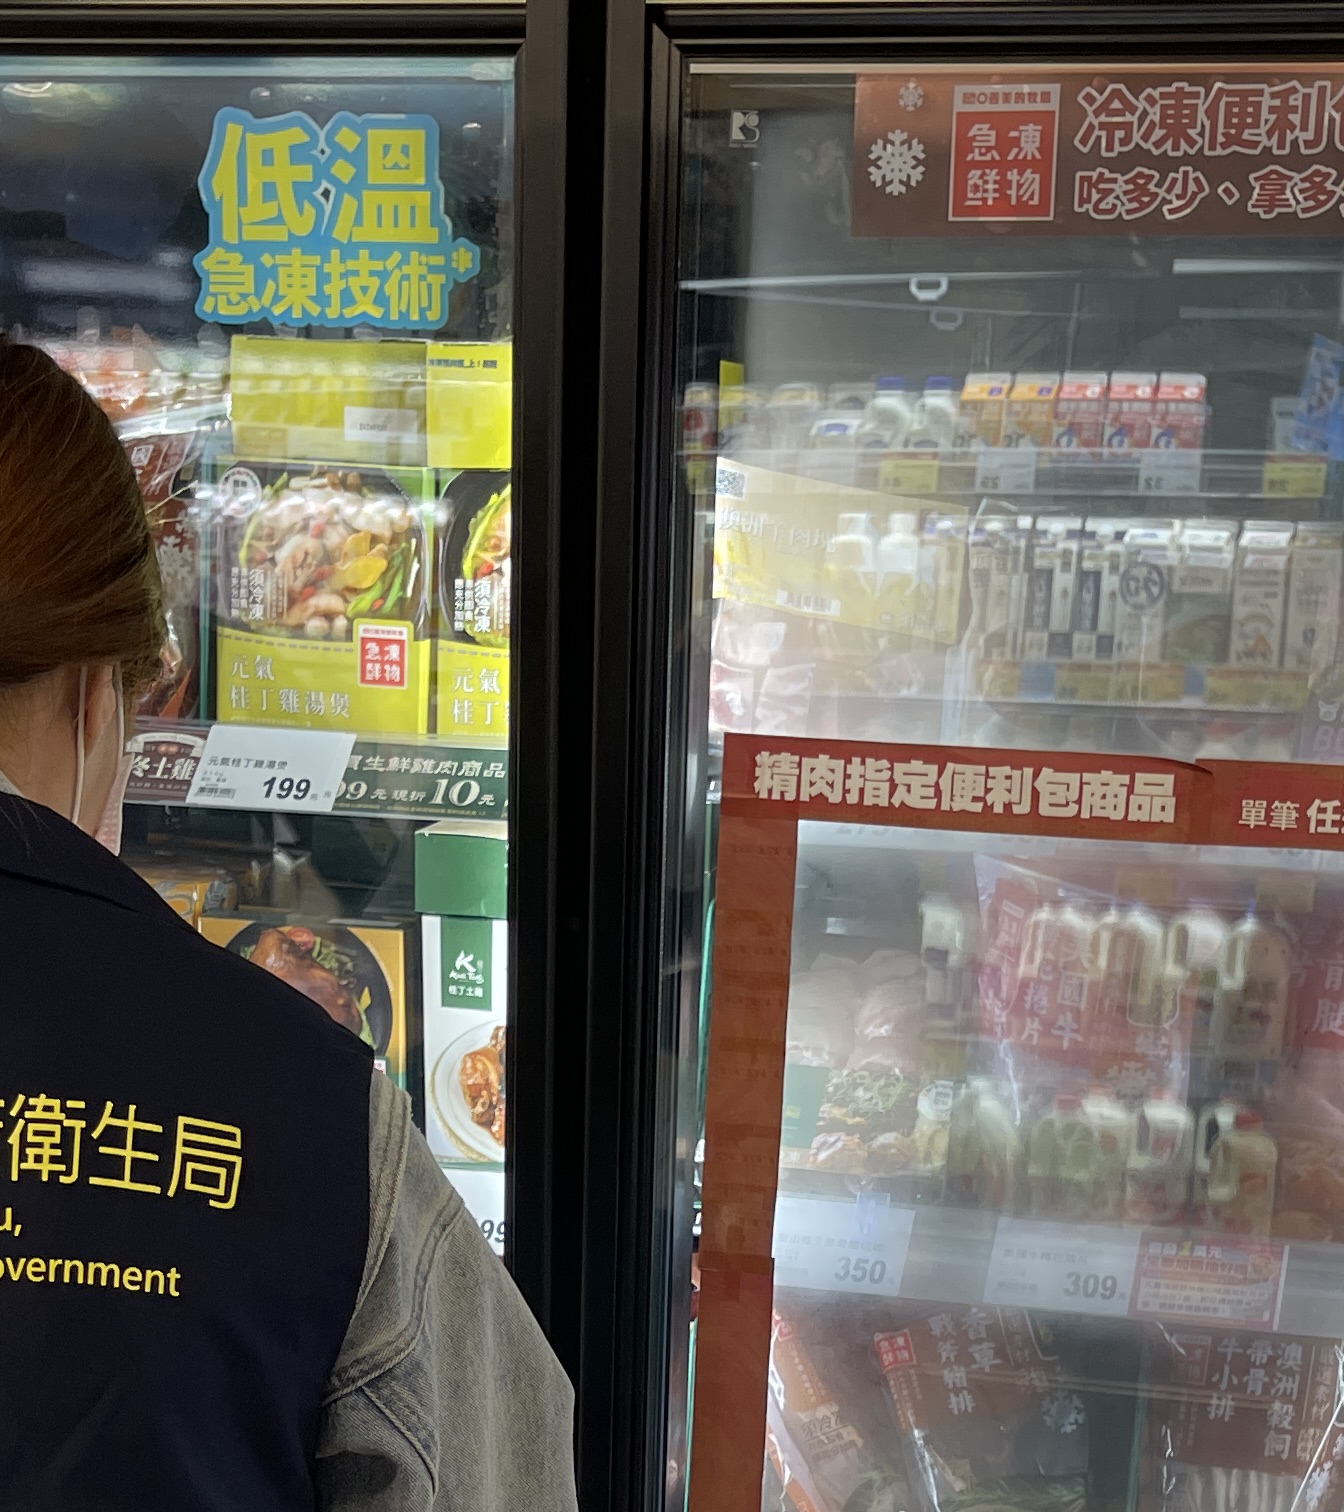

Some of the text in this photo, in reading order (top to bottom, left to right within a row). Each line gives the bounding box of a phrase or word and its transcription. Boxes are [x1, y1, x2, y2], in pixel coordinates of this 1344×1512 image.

[965, 122, 1043, 162] 急凍
[211, 122, 440, 245] 低溫
[965, 168, 1041, 207] 鮮物
[200, 247, 448, 321] 急凍技術
[230, 654, 275, 682] 元氣
[452, 667, 501, 695] 元氣
[229, 685, 351, 718] 桂丁雞湯煲
[452, 698, 509, 726] 桂丁
[261, 776, 311, 801] 199
[753, 752, 1178, 824] 精肉指定便利包商品
[1237, 797, 1299, 832] 單筆
[834, 1255, 887, 1285] 350
[1062, 1270, 1119, 1301] 309
[961, 1307, 1003, 1373] 香草
[1206, 1337, 1244, 1423] 牛小排
